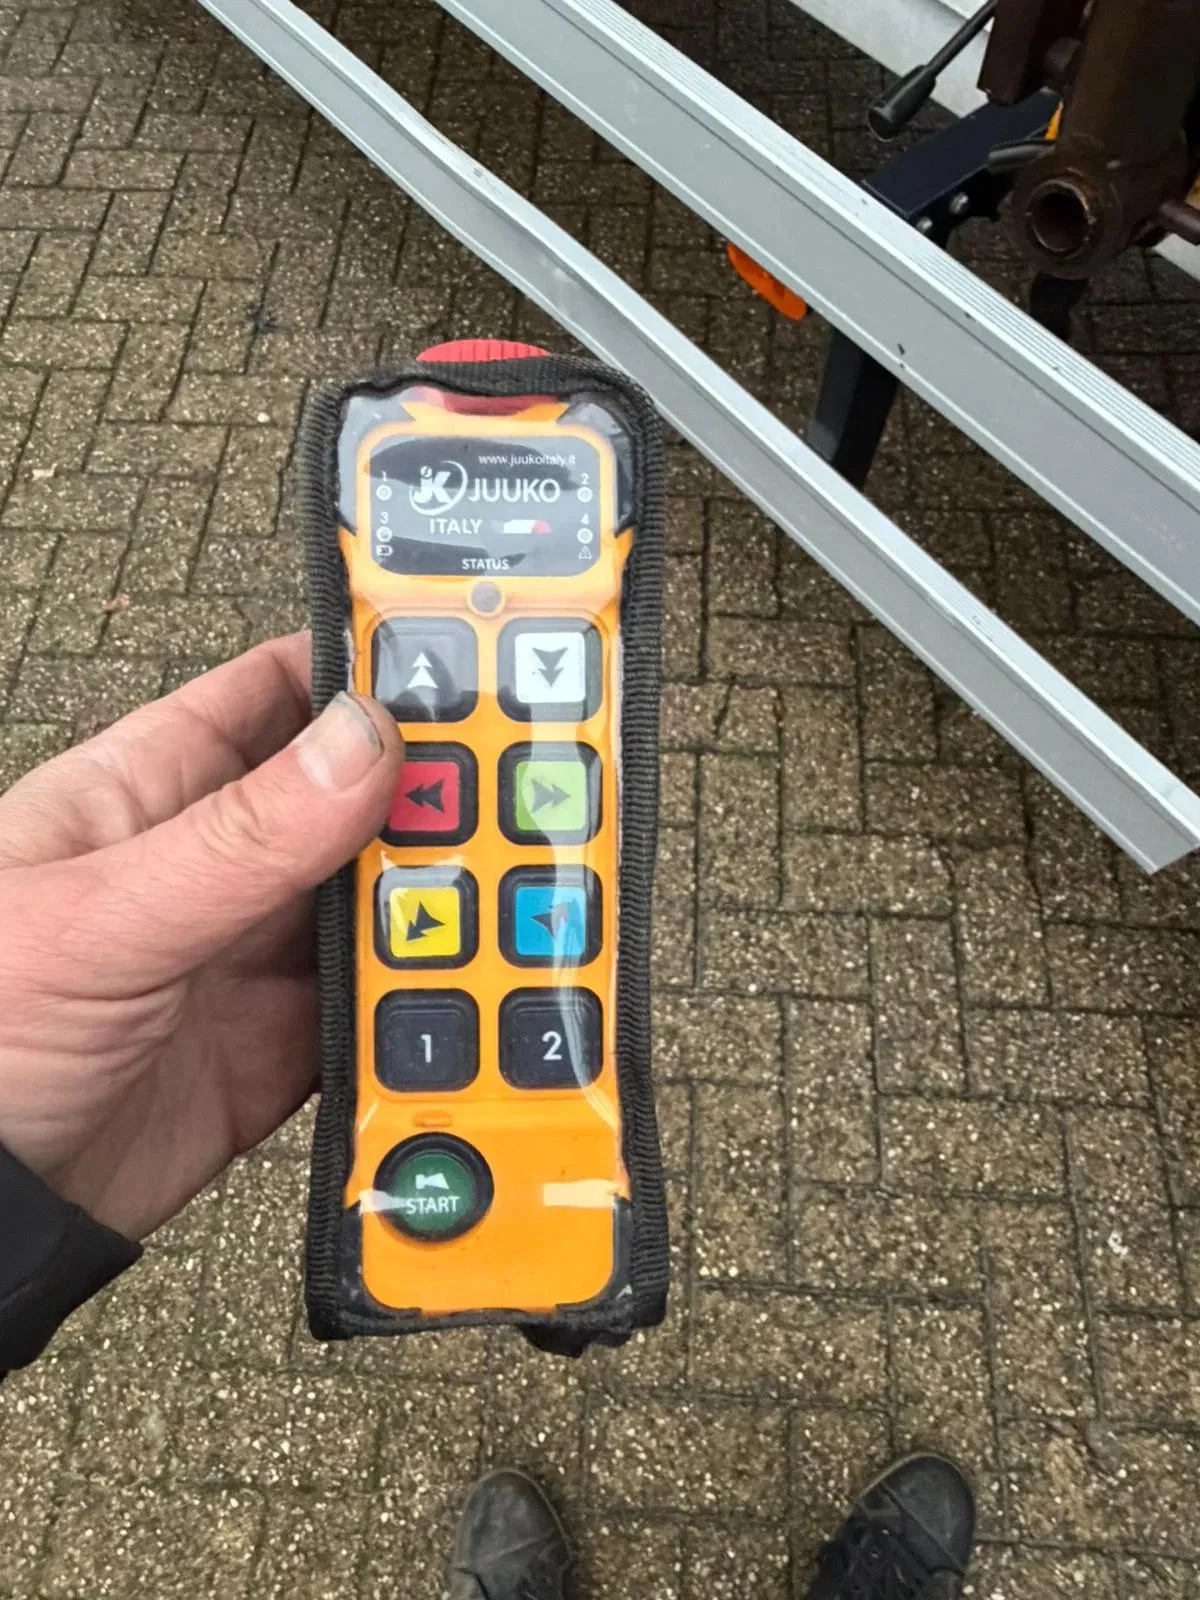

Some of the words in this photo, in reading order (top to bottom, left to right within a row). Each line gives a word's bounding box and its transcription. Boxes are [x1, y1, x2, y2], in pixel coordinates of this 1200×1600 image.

[381, 471, 388, 482] 1
[580, 473, 589, 485] 2
[467, 478, 561, 503] JUUKO
[379, 511, 389, 524] 3
[580, 513, 590, 525] 4
[429, 518, 483, 535] ITALY
[461, 557, 510, 570] STATUS
[420, 1034, 432, 1064] 1
[541, 1030, 563, 1061] 2
[405, 1195, 461, 1215] START
